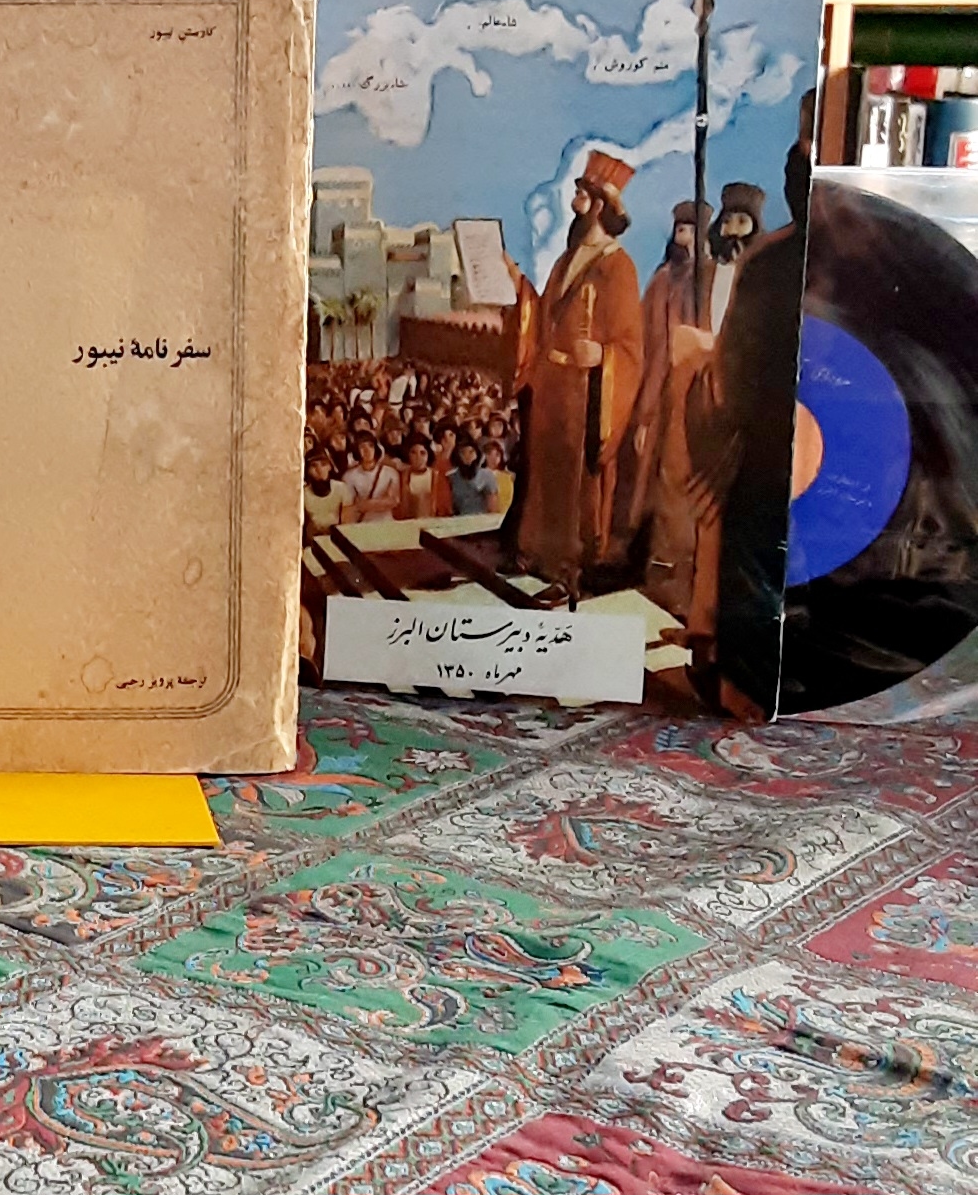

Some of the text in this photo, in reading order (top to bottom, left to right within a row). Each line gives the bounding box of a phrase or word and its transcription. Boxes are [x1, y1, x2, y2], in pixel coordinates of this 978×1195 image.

[71, 338, 125, 369] نیبور
[387, 617, 424, 646] البرز
[426, 617, 530, 653] دبیرستان
